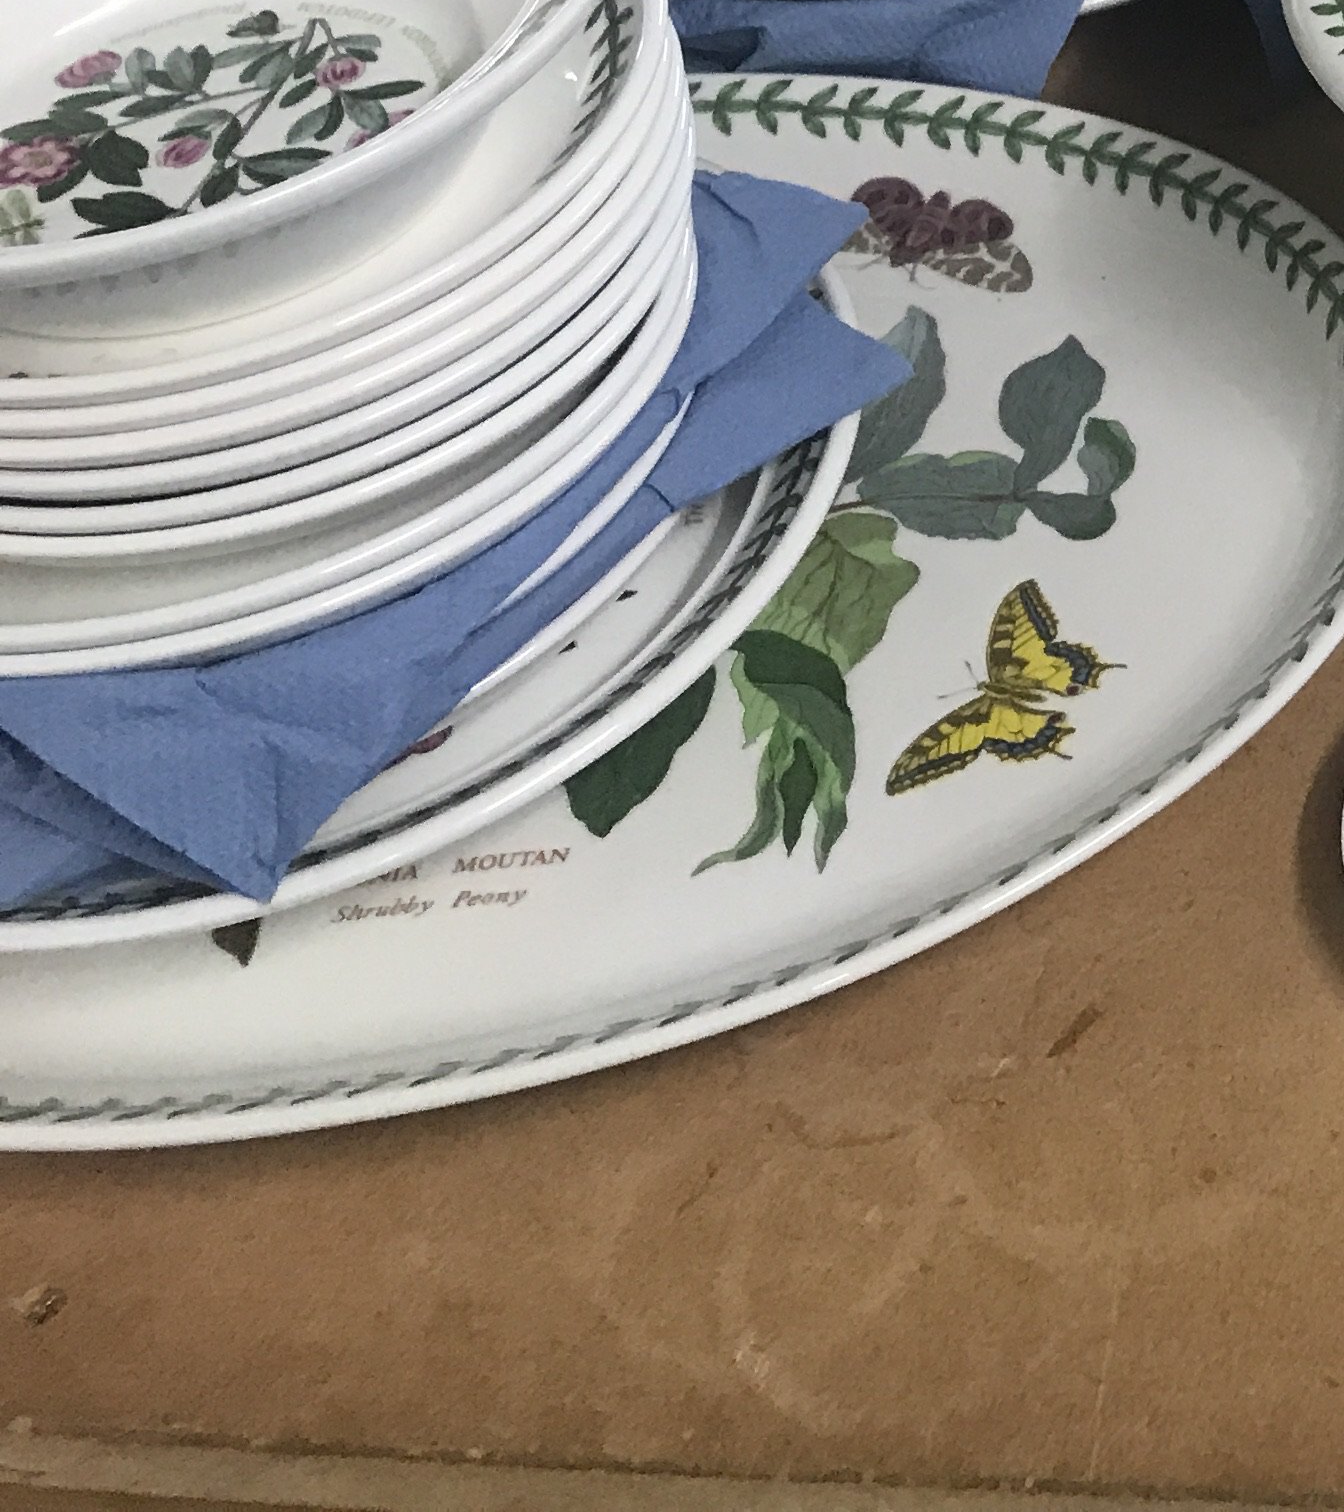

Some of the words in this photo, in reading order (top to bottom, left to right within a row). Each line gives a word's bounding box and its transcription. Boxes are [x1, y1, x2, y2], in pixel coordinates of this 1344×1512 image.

[452, 847, 571, 874] MOUTAN
[331, 895, 435, 924] Shrubby
[452, 888, 528, 908] Peony
